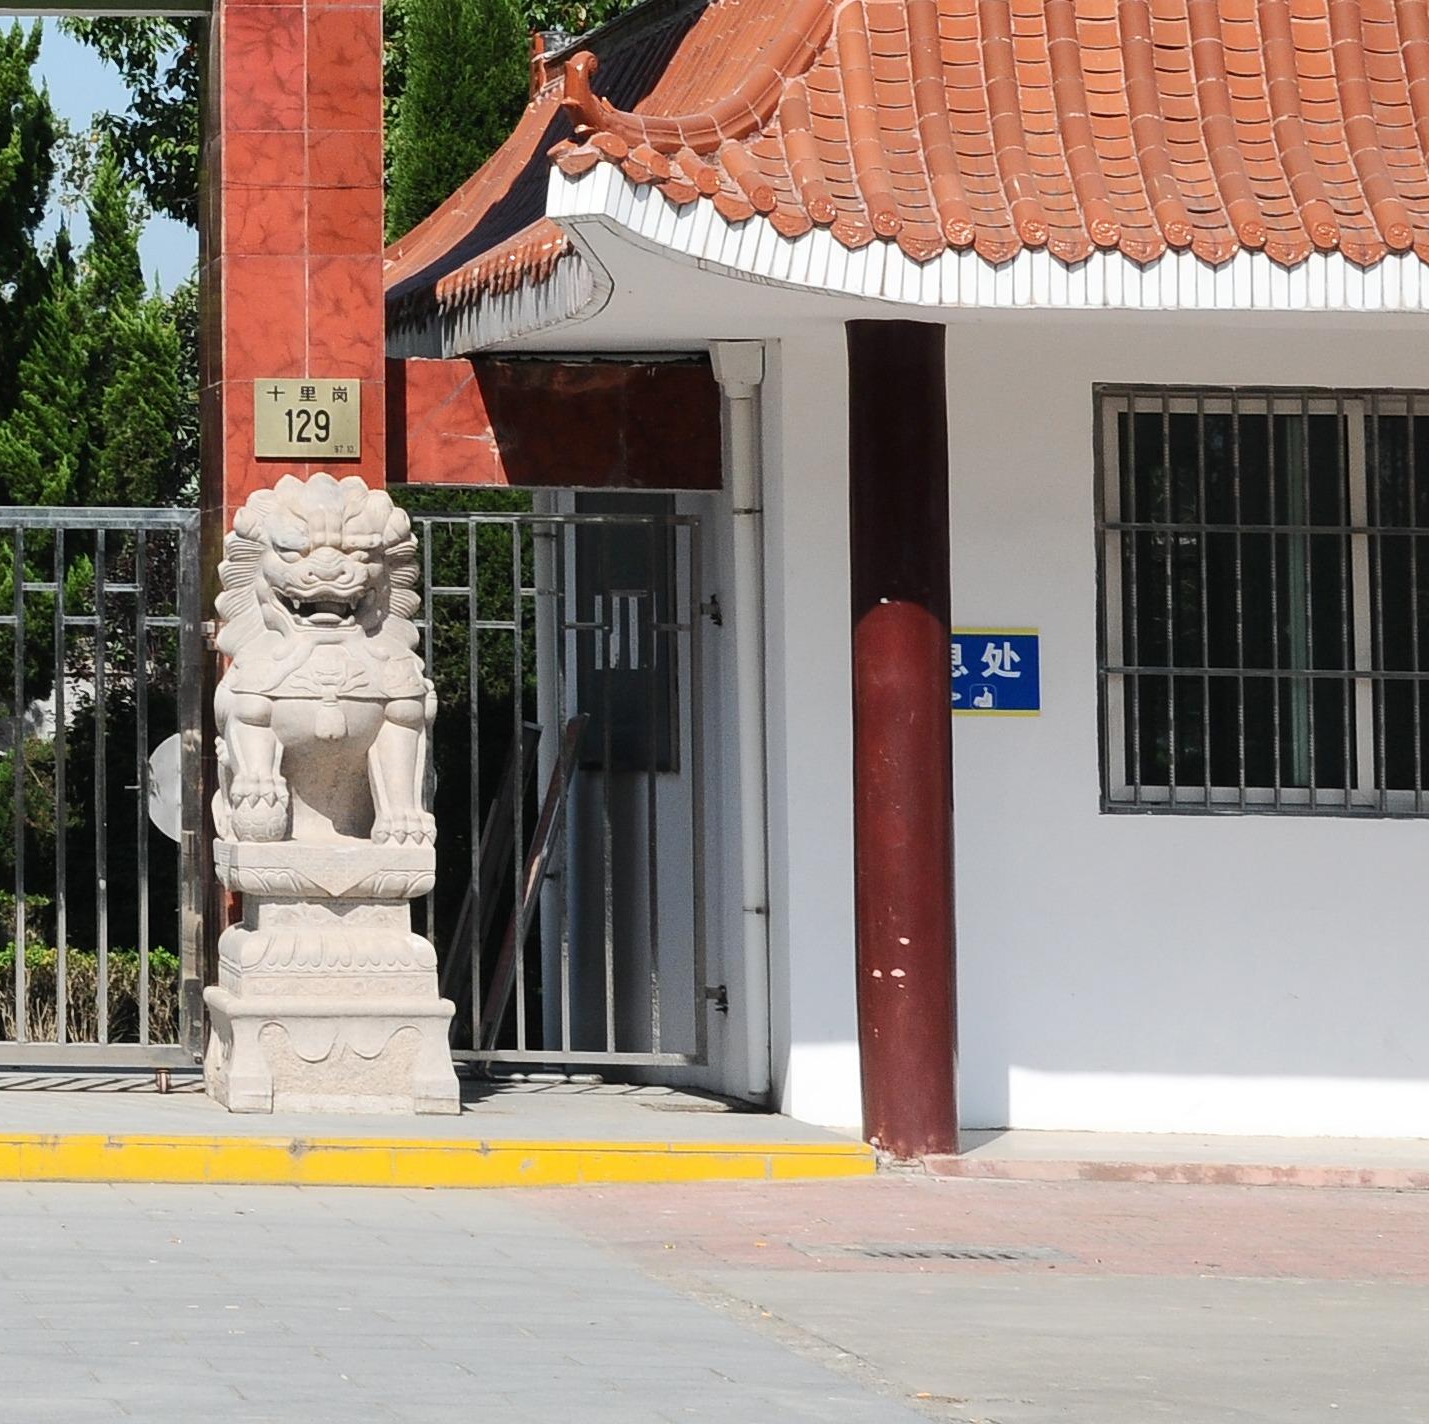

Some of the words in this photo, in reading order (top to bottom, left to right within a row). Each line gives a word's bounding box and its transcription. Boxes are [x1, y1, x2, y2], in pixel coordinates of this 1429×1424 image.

[267, 385, 348, 403] 十里岗
[284, 409, 330, 443] 129
